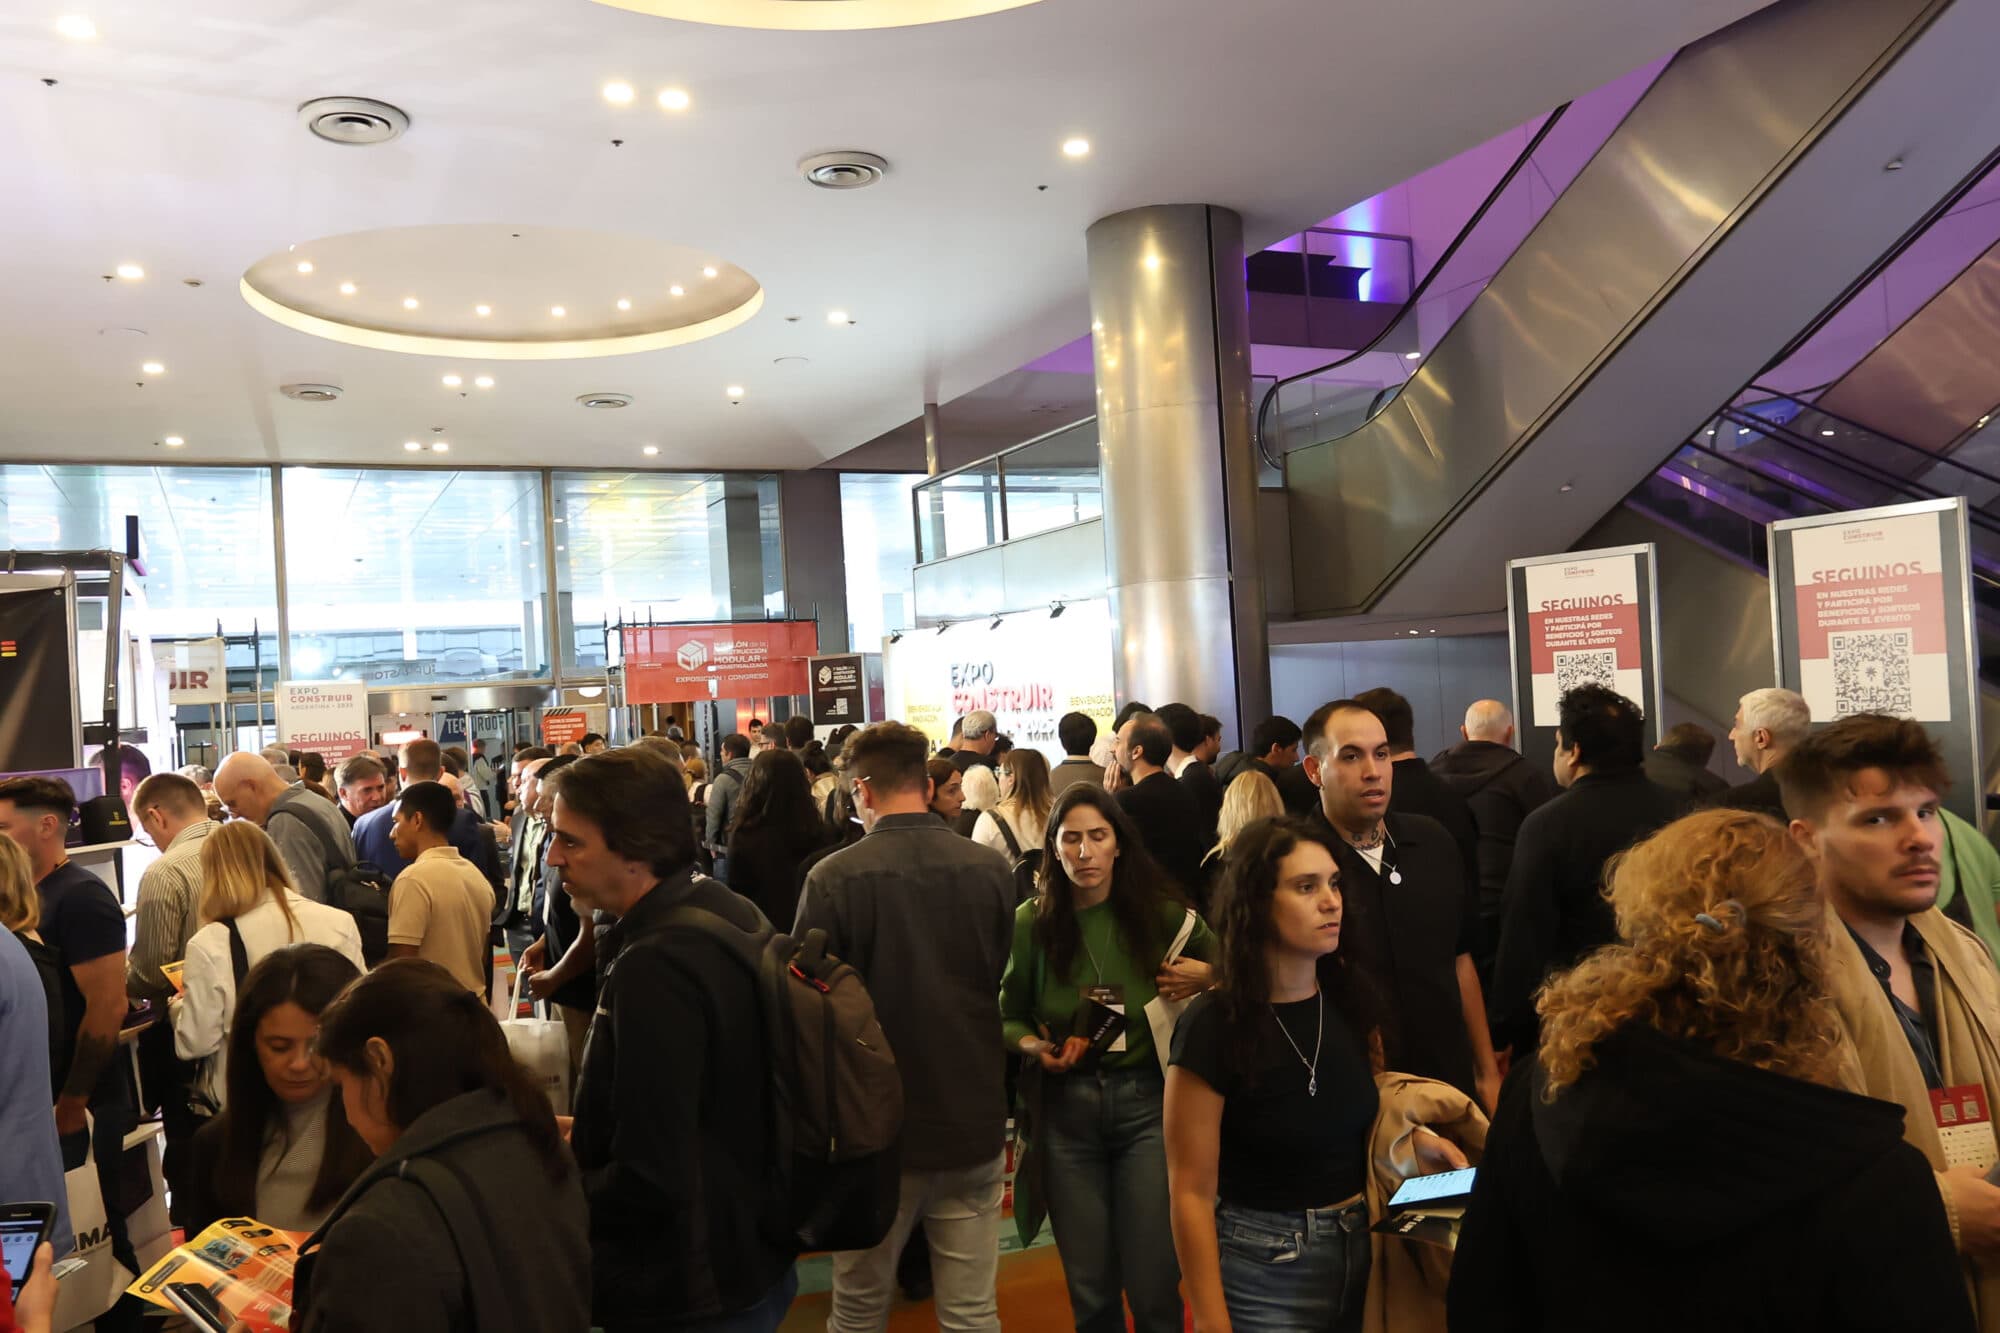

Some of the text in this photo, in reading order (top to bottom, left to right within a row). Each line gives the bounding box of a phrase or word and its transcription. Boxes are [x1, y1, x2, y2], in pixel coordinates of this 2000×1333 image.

[1811, 561, 1922, 583] SEGUINOS
[1830, 588, 1876, 598] NUESTRAS
[1878, 584, 1908, 594] REDES
[1541, 594, 1624, 612] SEGUINOS
[1873, 596, 1893, 604] POR
[1818, 607, 1869, 617] BENEFICIOS
[1555, 615, 1589, 623] NUESTRAS
[1818, 614, 1911, 627] DURANTE EL EVENTO
[1545, 631, 1585, 640] BENEFICIOS
[1591, 628, 1623, 637] SORTEOS
[1545, 639, 1577, 647] DURANTE
[1588, 637, 1616, 645] EVENTO
[714, 655, 760, 664] MODULAR
[728, 673, 769, 681] CONGRESO
[951, 661, 994, 688] EXPO
[290, 687, 319, 695] EXPO
[290, 694, 353, 703] CONSTRUIR
[290, 731, 361, 743] SEGUINOS
